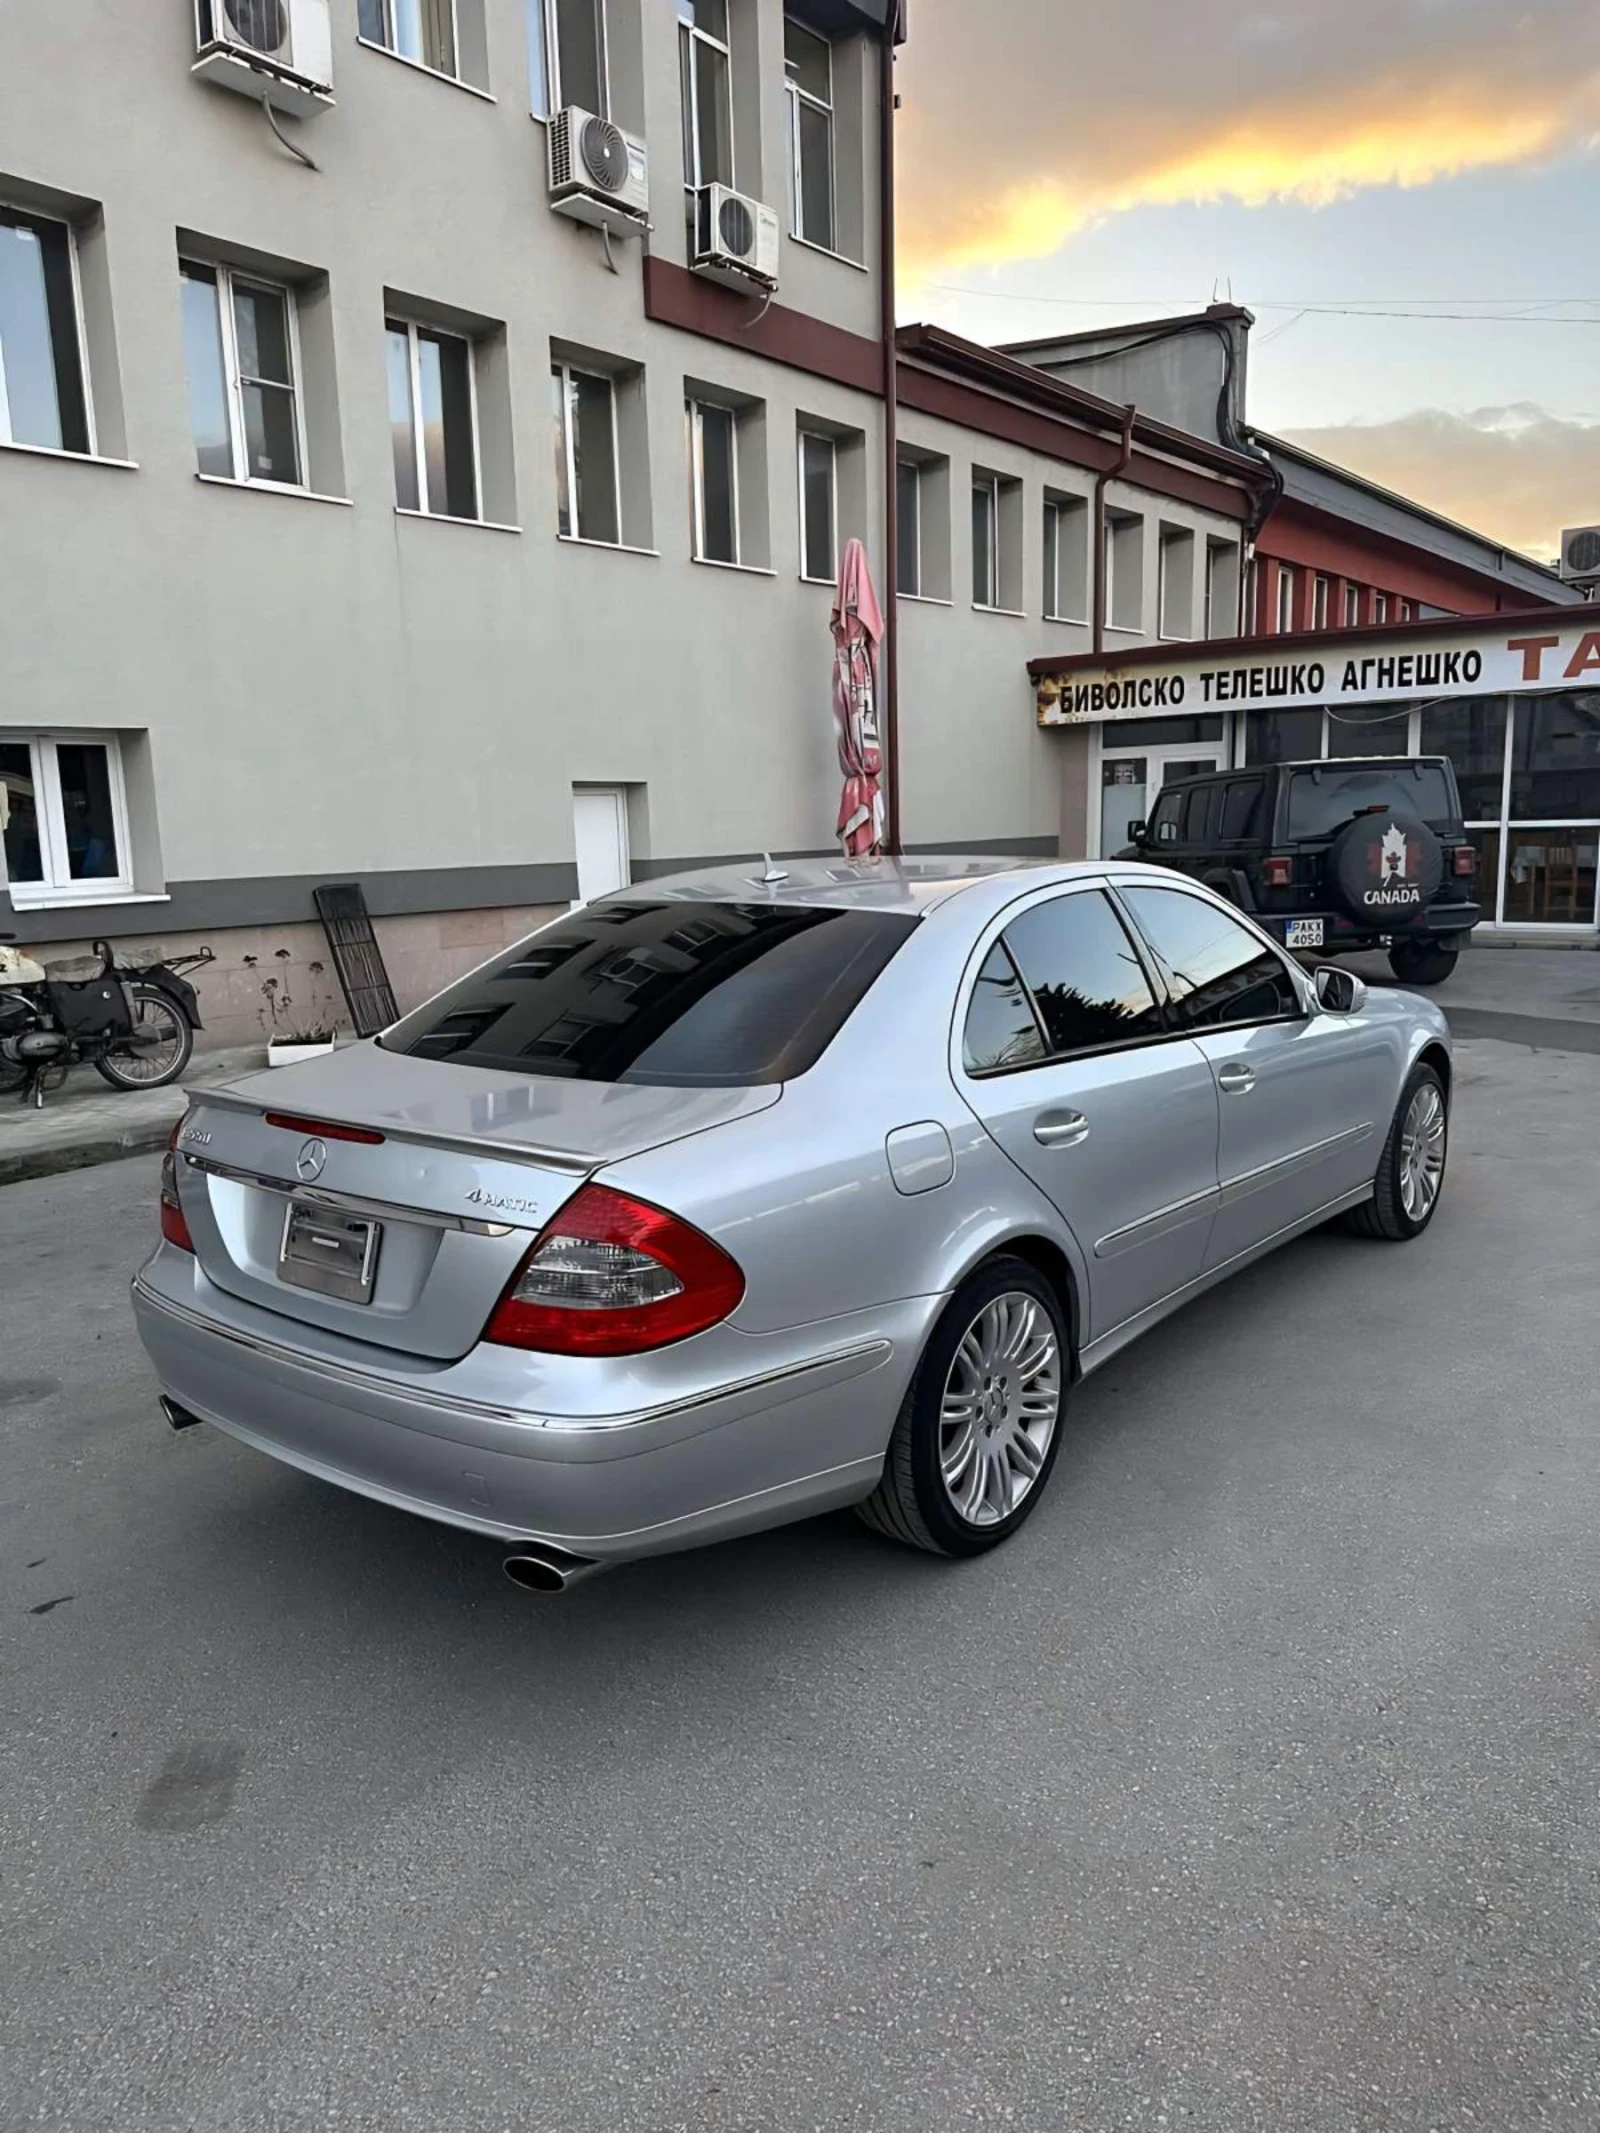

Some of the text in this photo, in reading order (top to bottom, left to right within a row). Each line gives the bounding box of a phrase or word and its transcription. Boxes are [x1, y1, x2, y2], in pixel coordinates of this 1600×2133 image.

[1507, 632, 1600, 681] ТА
[1060, 650, 1482, 714] БИВОЛСКО ТЕЛЕШКО АГНЕШКО
[1363, 889, 1420, 905] CANADA
[1292, 933, 1322, 945] 4050
